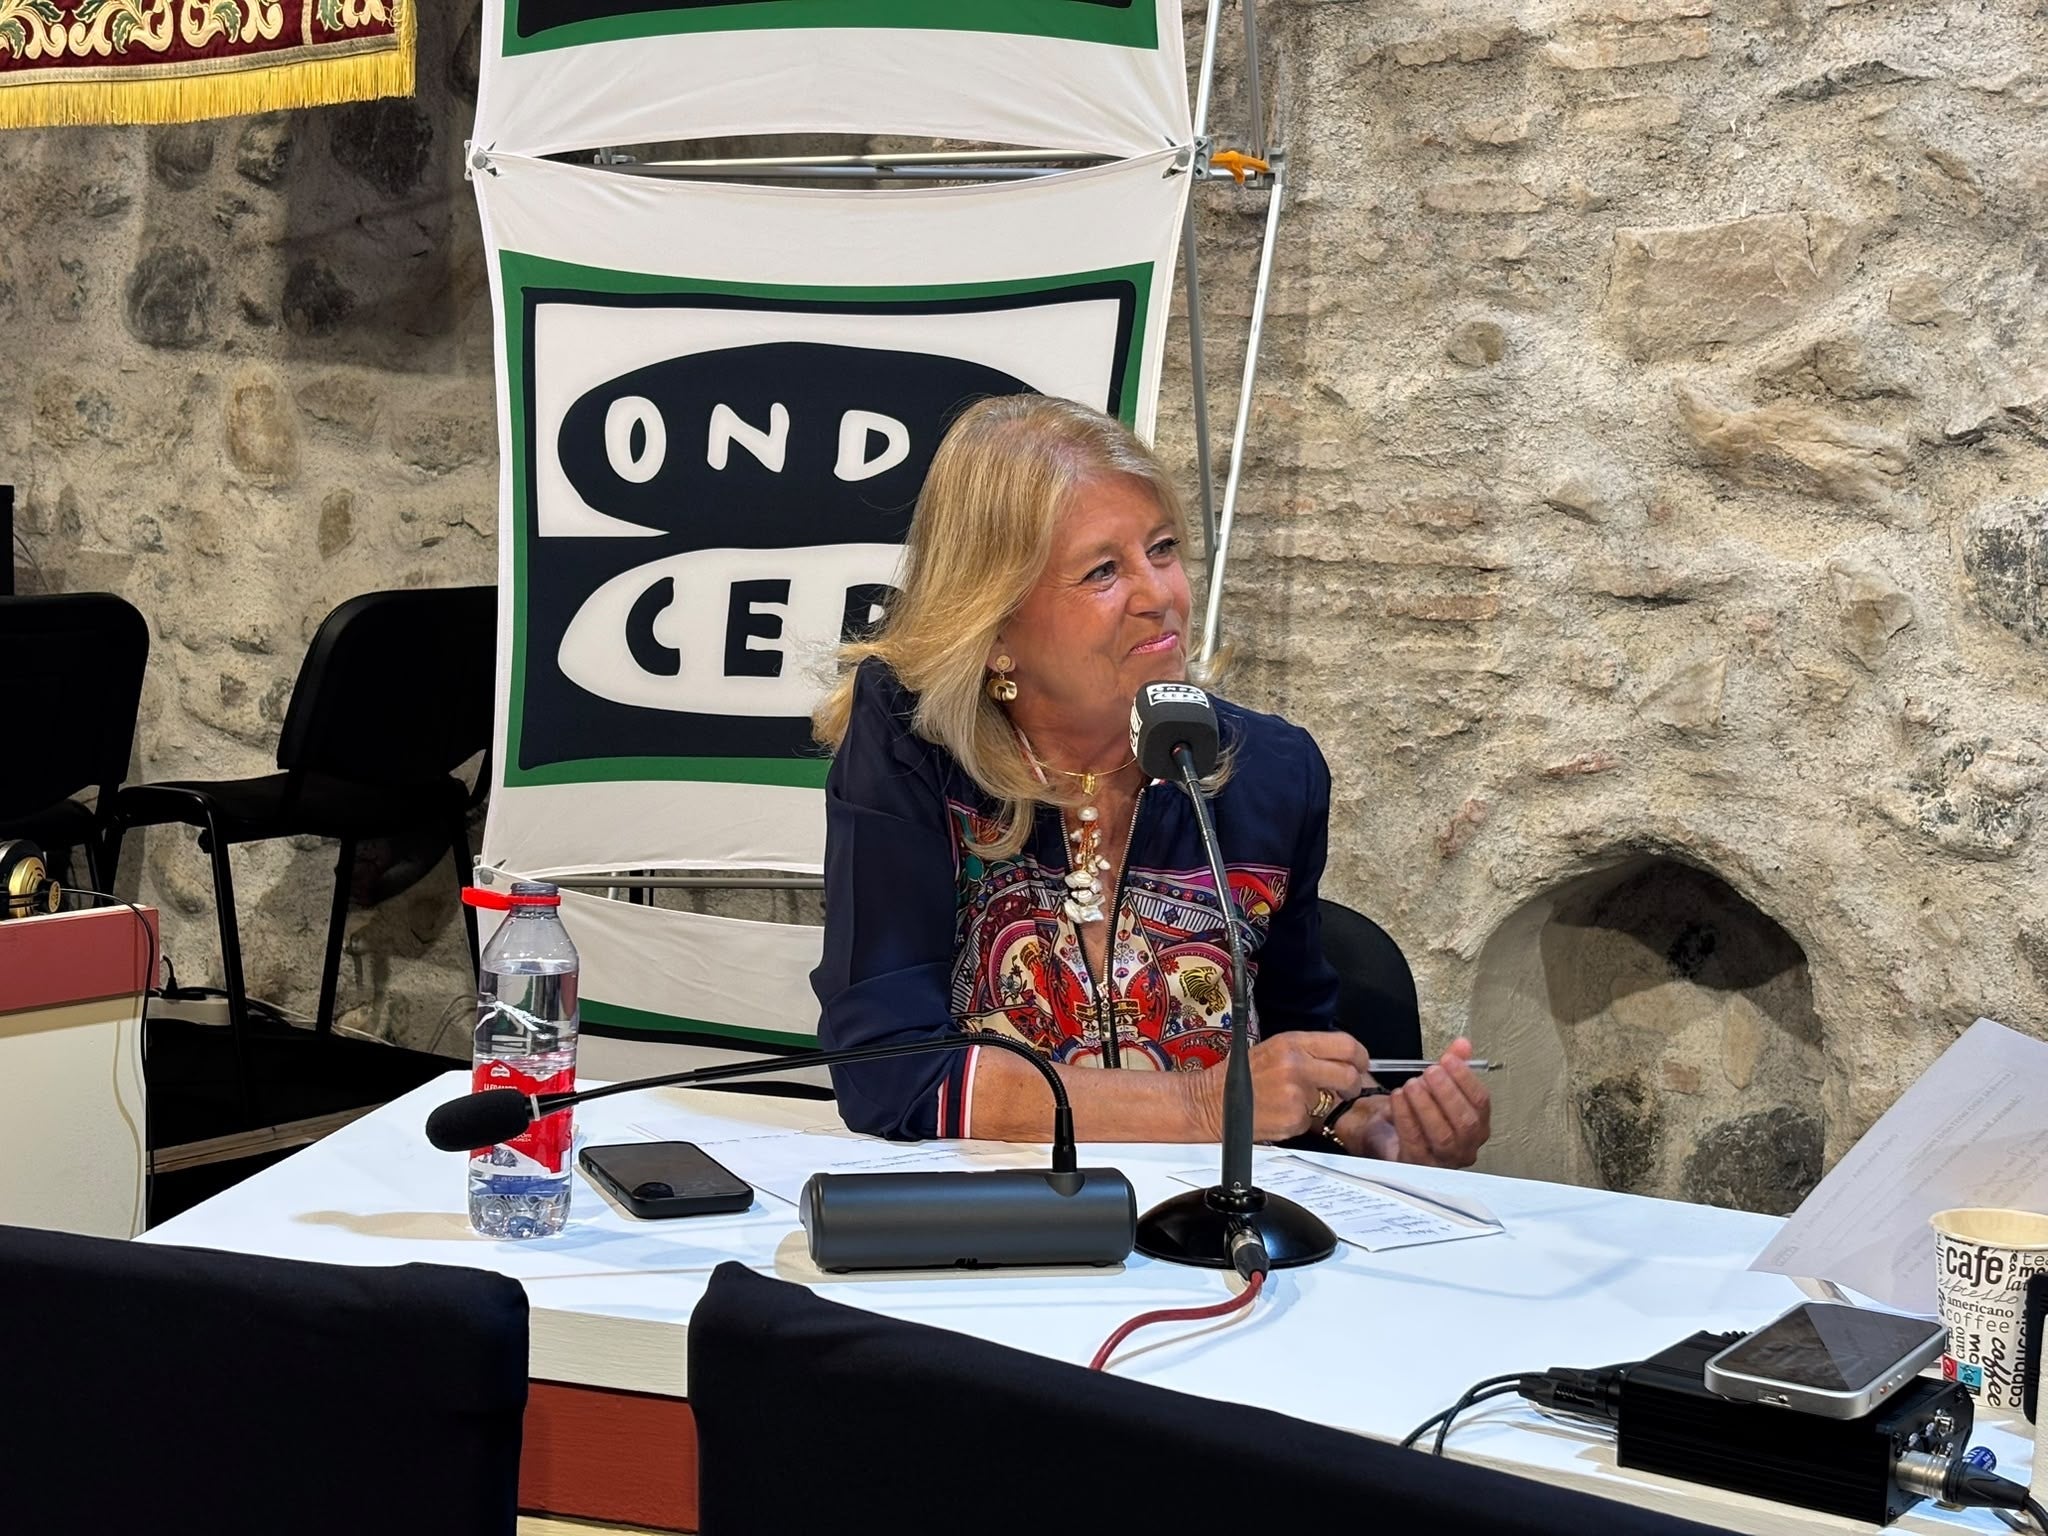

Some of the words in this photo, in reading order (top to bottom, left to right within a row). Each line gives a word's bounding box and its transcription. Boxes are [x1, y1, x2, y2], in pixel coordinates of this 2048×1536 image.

[604, 394, 911, 484] OND
[1946, 1245, 2004, 1288] café
[1946, 1308, 2010, 1334] coffee
[1947, 1296, 2014, 1319] americano
[1981, 1336, 2012, 1407] coffee
